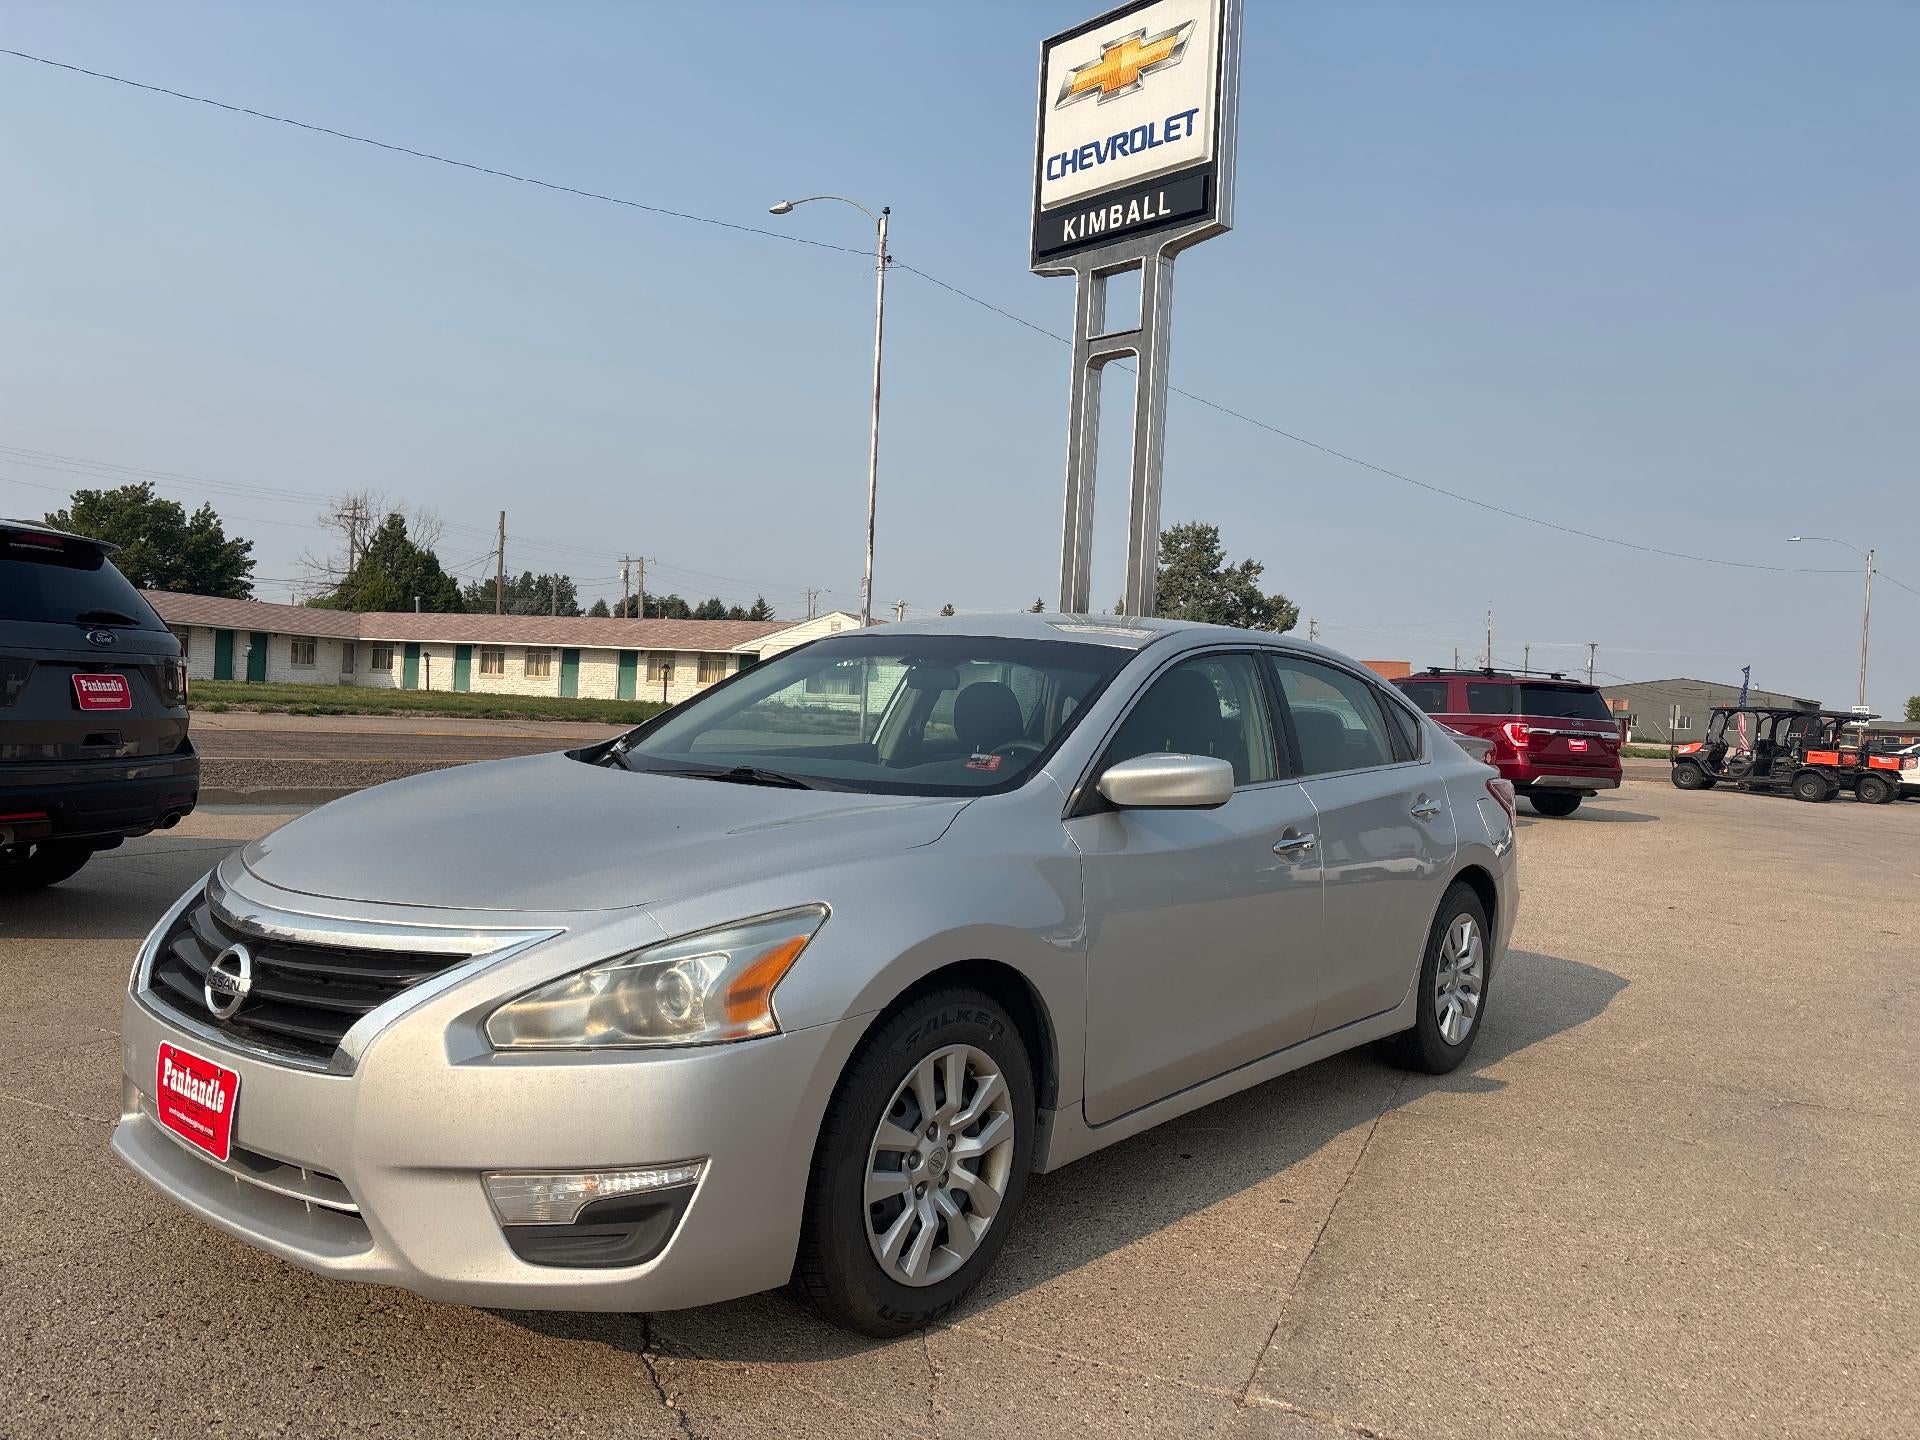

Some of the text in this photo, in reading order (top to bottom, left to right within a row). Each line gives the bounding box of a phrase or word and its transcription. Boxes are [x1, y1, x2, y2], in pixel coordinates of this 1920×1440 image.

[1046, 107, 1199, 180] CHEVROLET
[1063, 191, 1171, 242] KIMBALL
[80, 680, 124, 692] Panhandle
[162, 1057, 226, 1114] Panhandle
